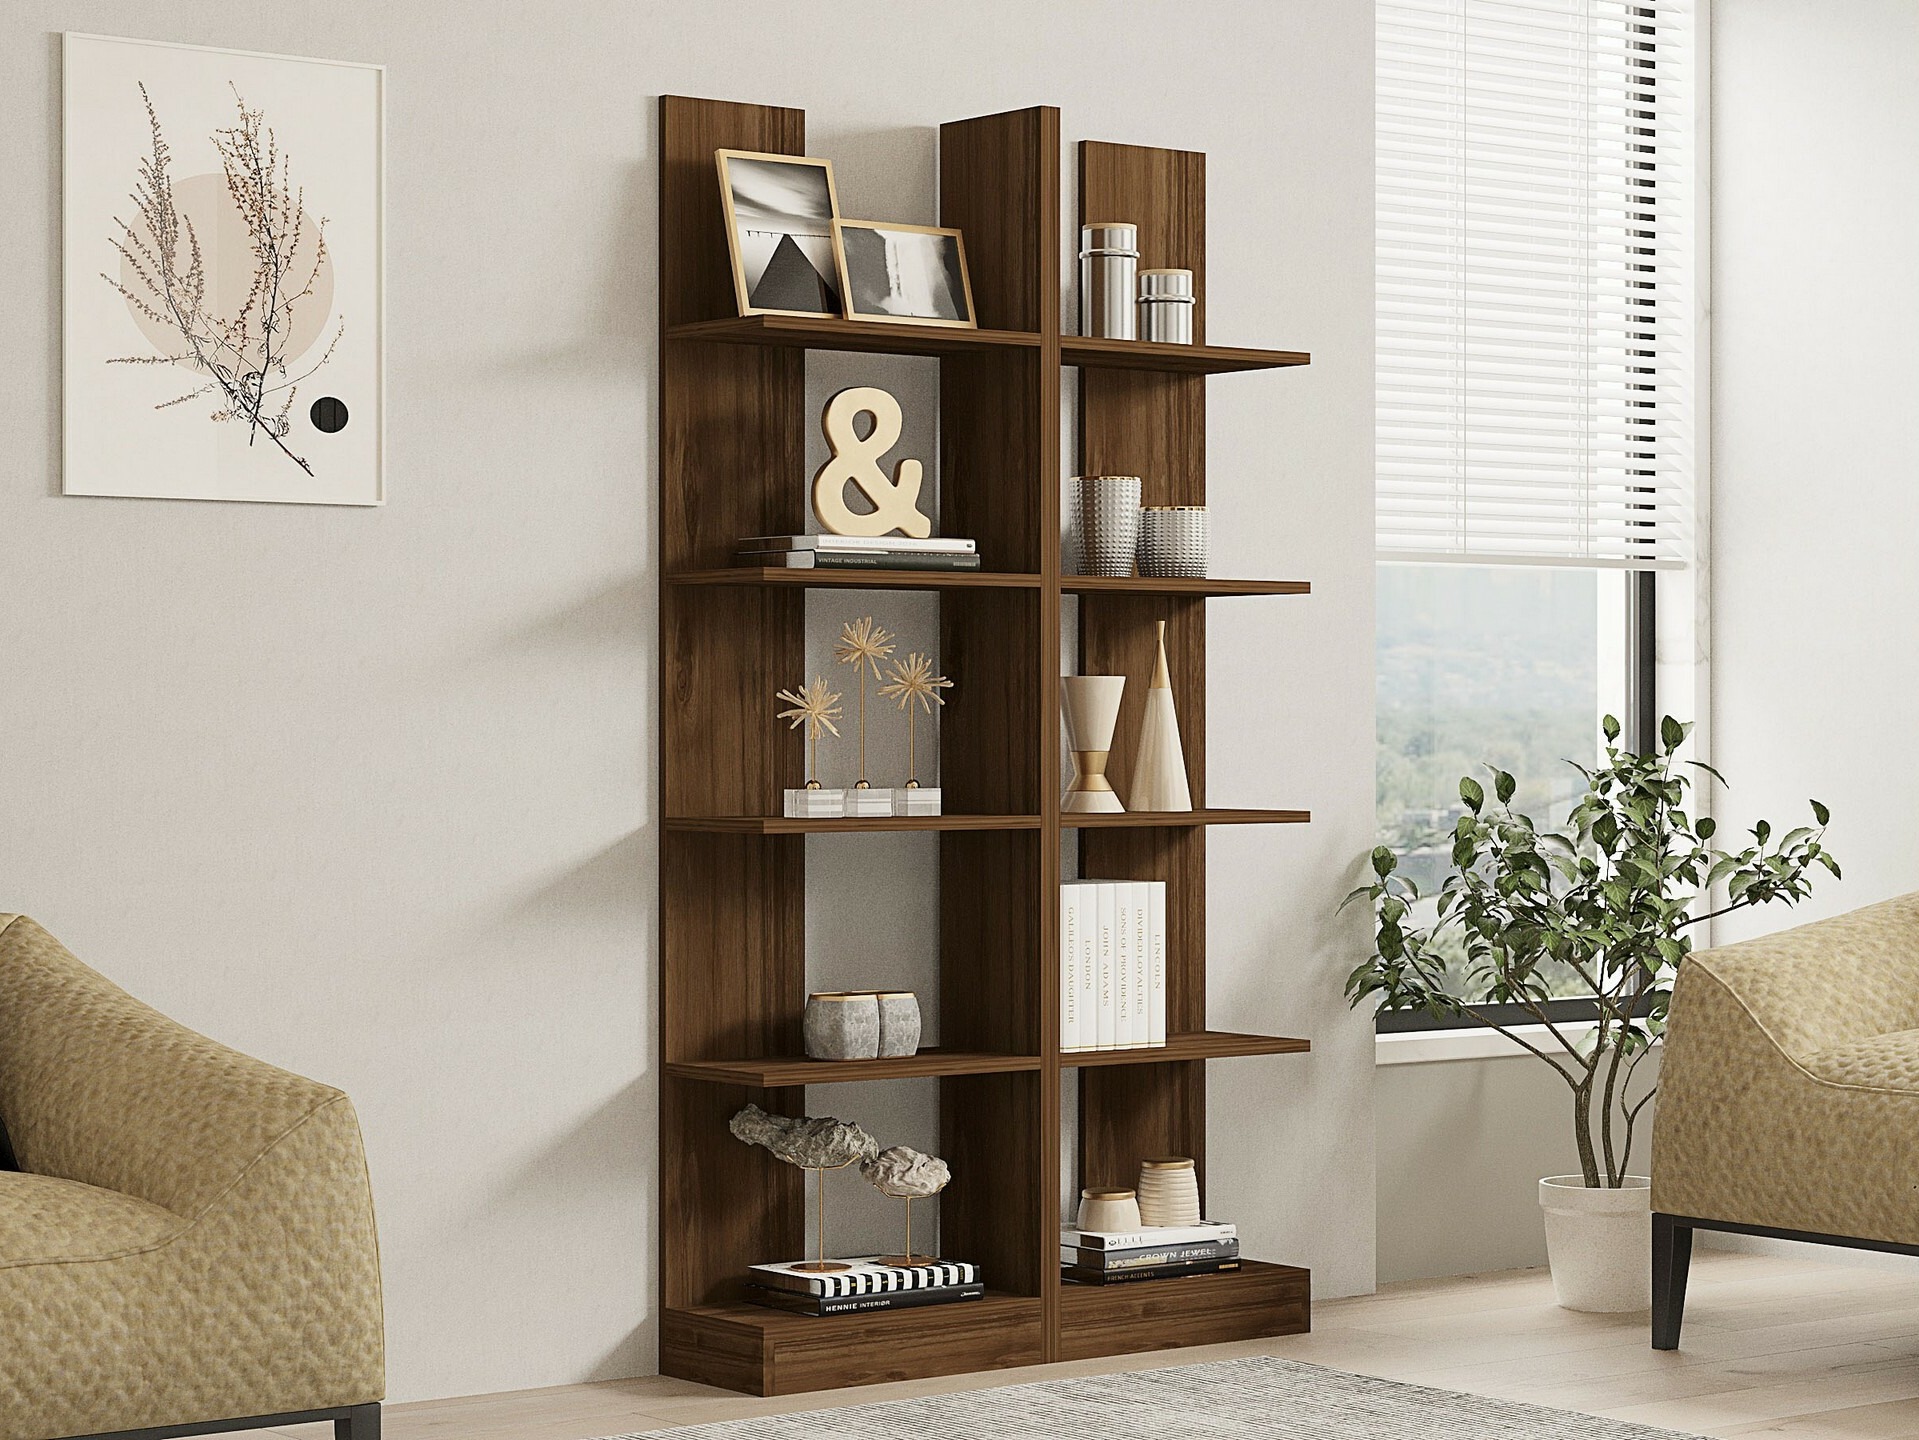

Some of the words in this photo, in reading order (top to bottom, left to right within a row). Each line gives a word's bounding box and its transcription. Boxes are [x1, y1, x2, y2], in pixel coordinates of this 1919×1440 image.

[844, 557, 878, 565] INDUSTRIAL
[1120, 937, 1127, 952] OF
[1139, 1251, 1177, 1261] CROWN
[1129, 1271, 1155, 1280] ACCENTS
[825, 1302, 858, 1312] HENNIE
